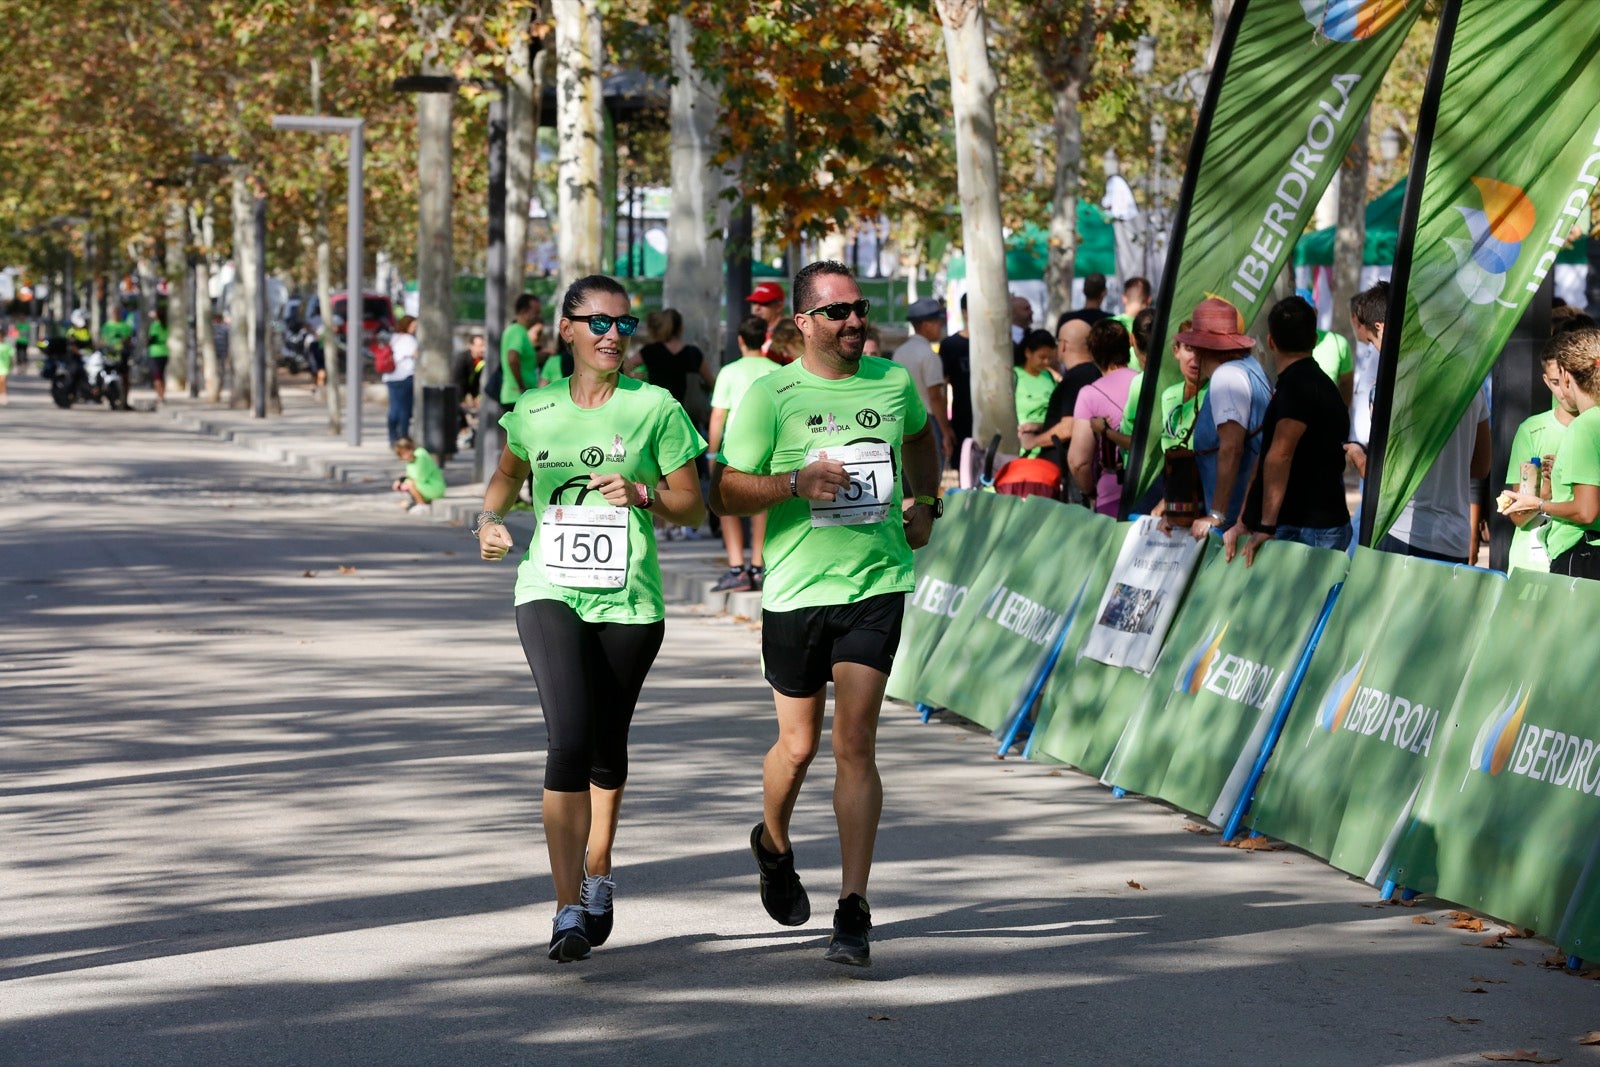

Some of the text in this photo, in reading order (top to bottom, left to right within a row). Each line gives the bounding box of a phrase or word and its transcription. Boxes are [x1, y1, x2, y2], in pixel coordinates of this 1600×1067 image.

[1232, 72, 1362, 303] IBERDROLA
[537, 461, 574, 469] IBERDROLA
[553, 531, 613, 564] 150
